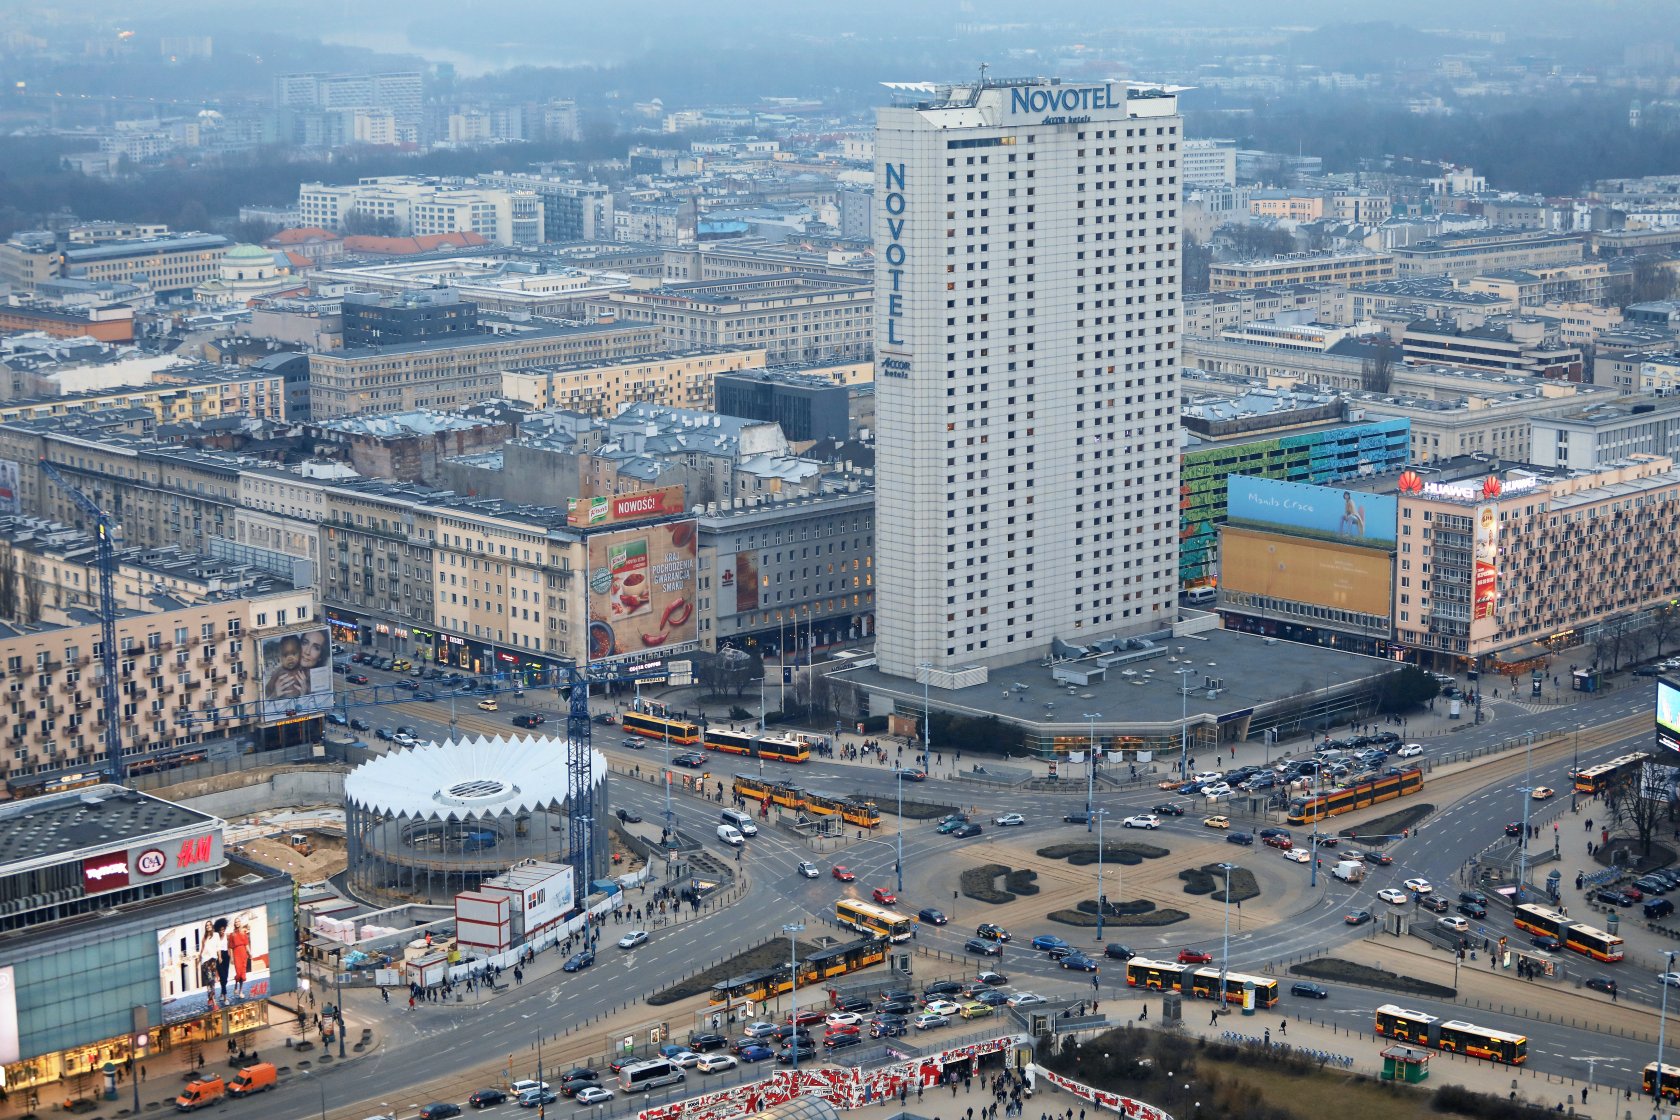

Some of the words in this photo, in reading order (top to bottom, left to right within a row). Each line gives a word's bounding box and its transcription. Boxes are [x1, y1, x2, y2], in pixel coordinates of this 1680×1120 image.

[1011, 83, 1120, 114] NOVOTEL
[1068, 115, 1091, 124] hotels
[885, 162, 906, 346] NOVOTEL
[884, 369, 909, 379] hotels
[1424, 482, 1474, 498] HUAWEI
[1502, 476, 1536, 493] HUAWEI
[590, 505, 608, 517] Knorr
[618, 497, 655, 514] NOWOŚĆ!
[1248, 493, 1280, 507] Manila
[1283, 498, 1314, 513] Grace
[664, 551, 680, 563] KRAJ
[652, 559, 694, 575] POCHODZENIA
[662, 580, 684, 593] SMAKU
[177, 835, 213, 868] H&M
[142, 855, 161, 869] C&A
[249, 980, 269, 997] H&M
